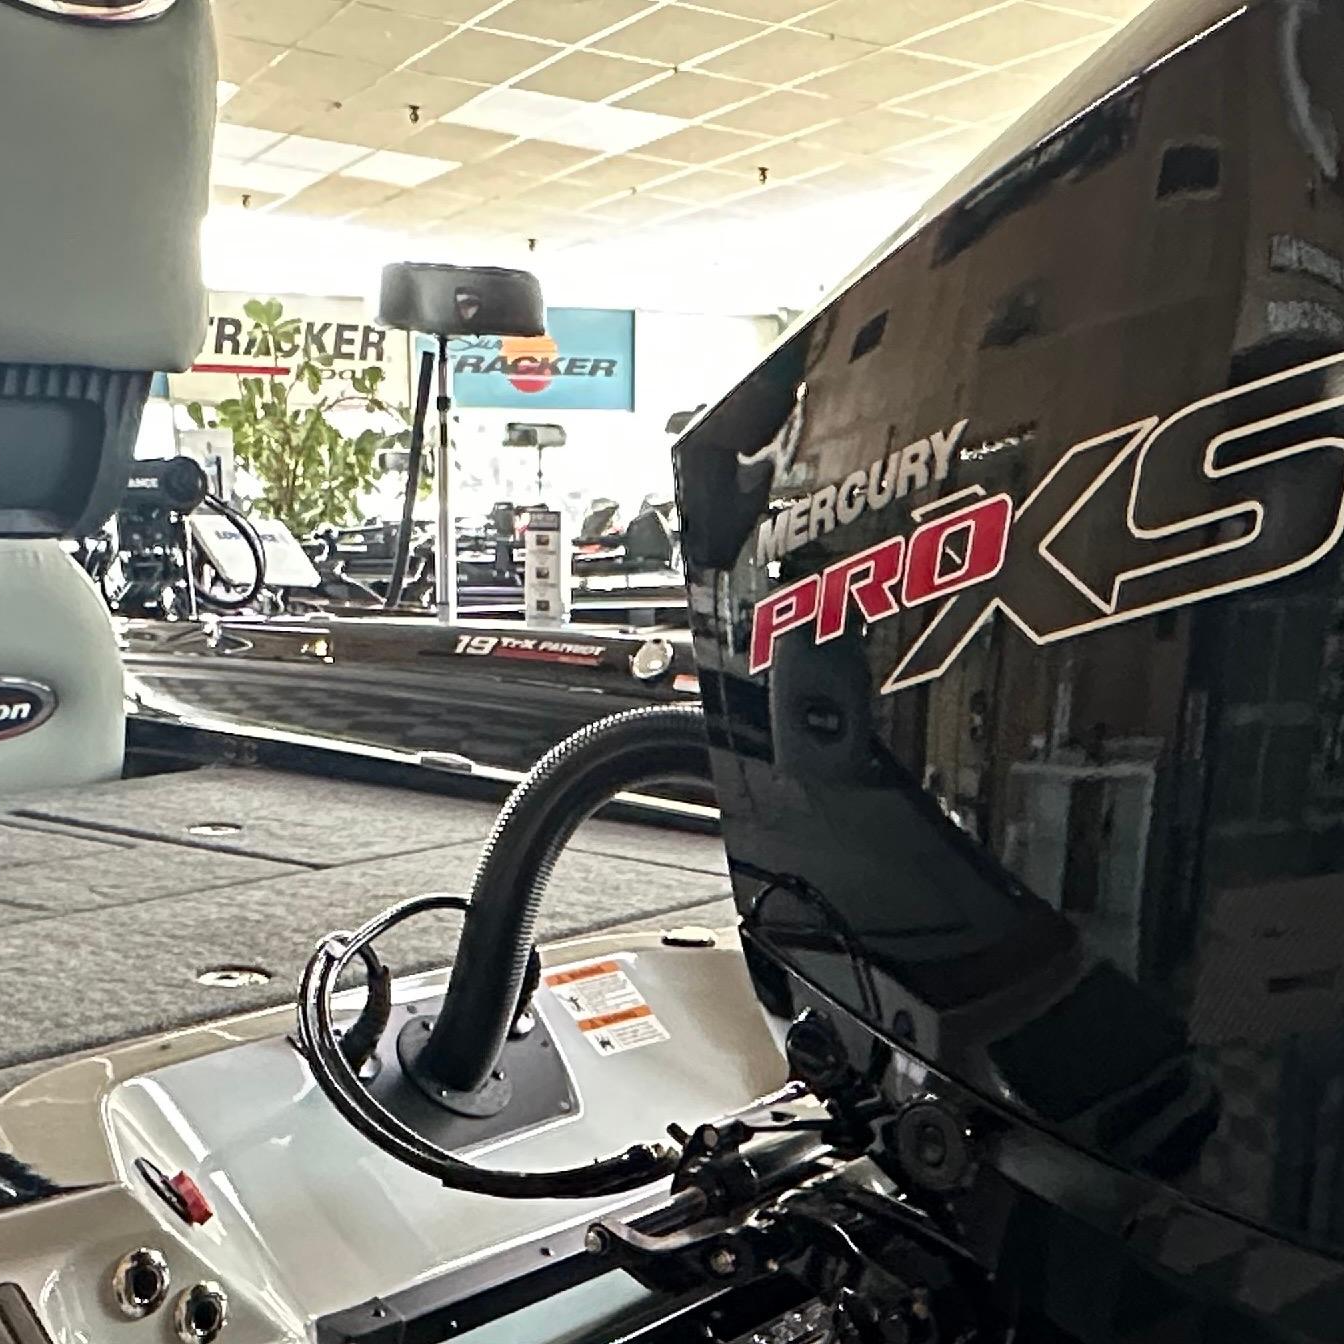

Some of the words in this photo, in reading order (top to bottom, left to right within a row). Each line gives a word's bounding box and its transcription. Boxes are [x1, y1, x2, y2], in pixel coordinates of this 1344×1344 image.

[209, 316, 386, 362] RACKER
[453, 354, 618, 377] RACKER
[757, 418, 969, 567] MERCURY
[749, 493, 1014, 675] PRO
[454, 634, 499, 656] 19
